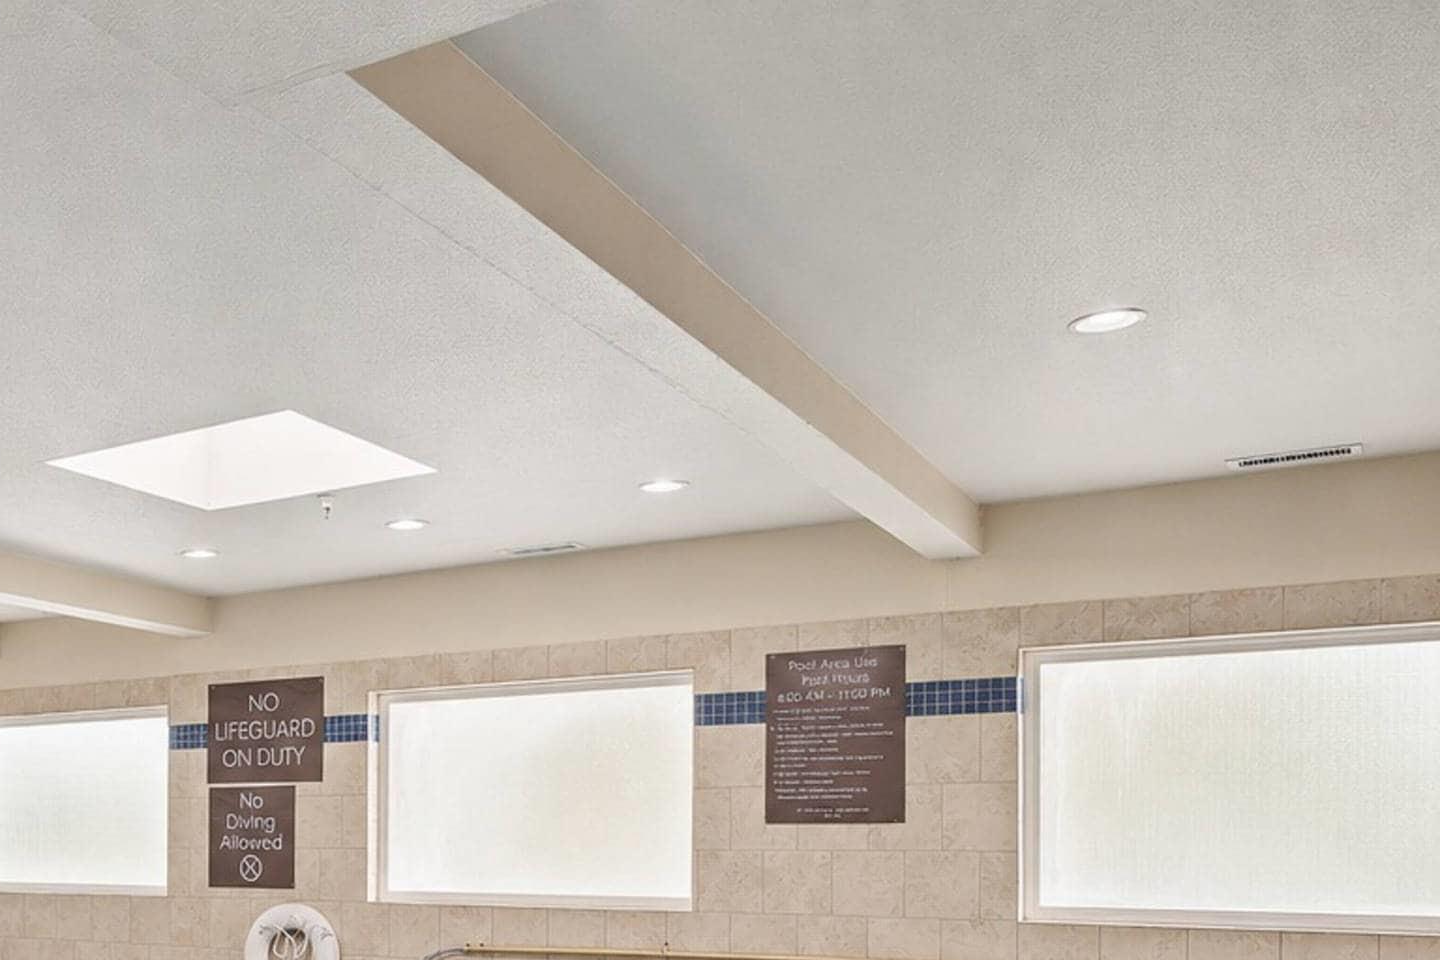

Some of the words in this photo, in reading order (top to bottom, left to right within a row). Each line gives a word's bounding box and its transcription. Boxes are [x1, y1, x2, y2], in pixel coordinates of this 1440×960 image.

[820, 659, 850, 670] Area
[871, 687, 892, 698] PM
[248, 692, 280, 713] NO
[215, 717, 316, 742] LIFEGUARD
[222, 749, 253, 768] ON
[257, 746, 306, 767] DUTY
[239, 792, 264, 810] No
[225, 813, 277, 834] Diving
[219, 833, 283, 851] Allowed
